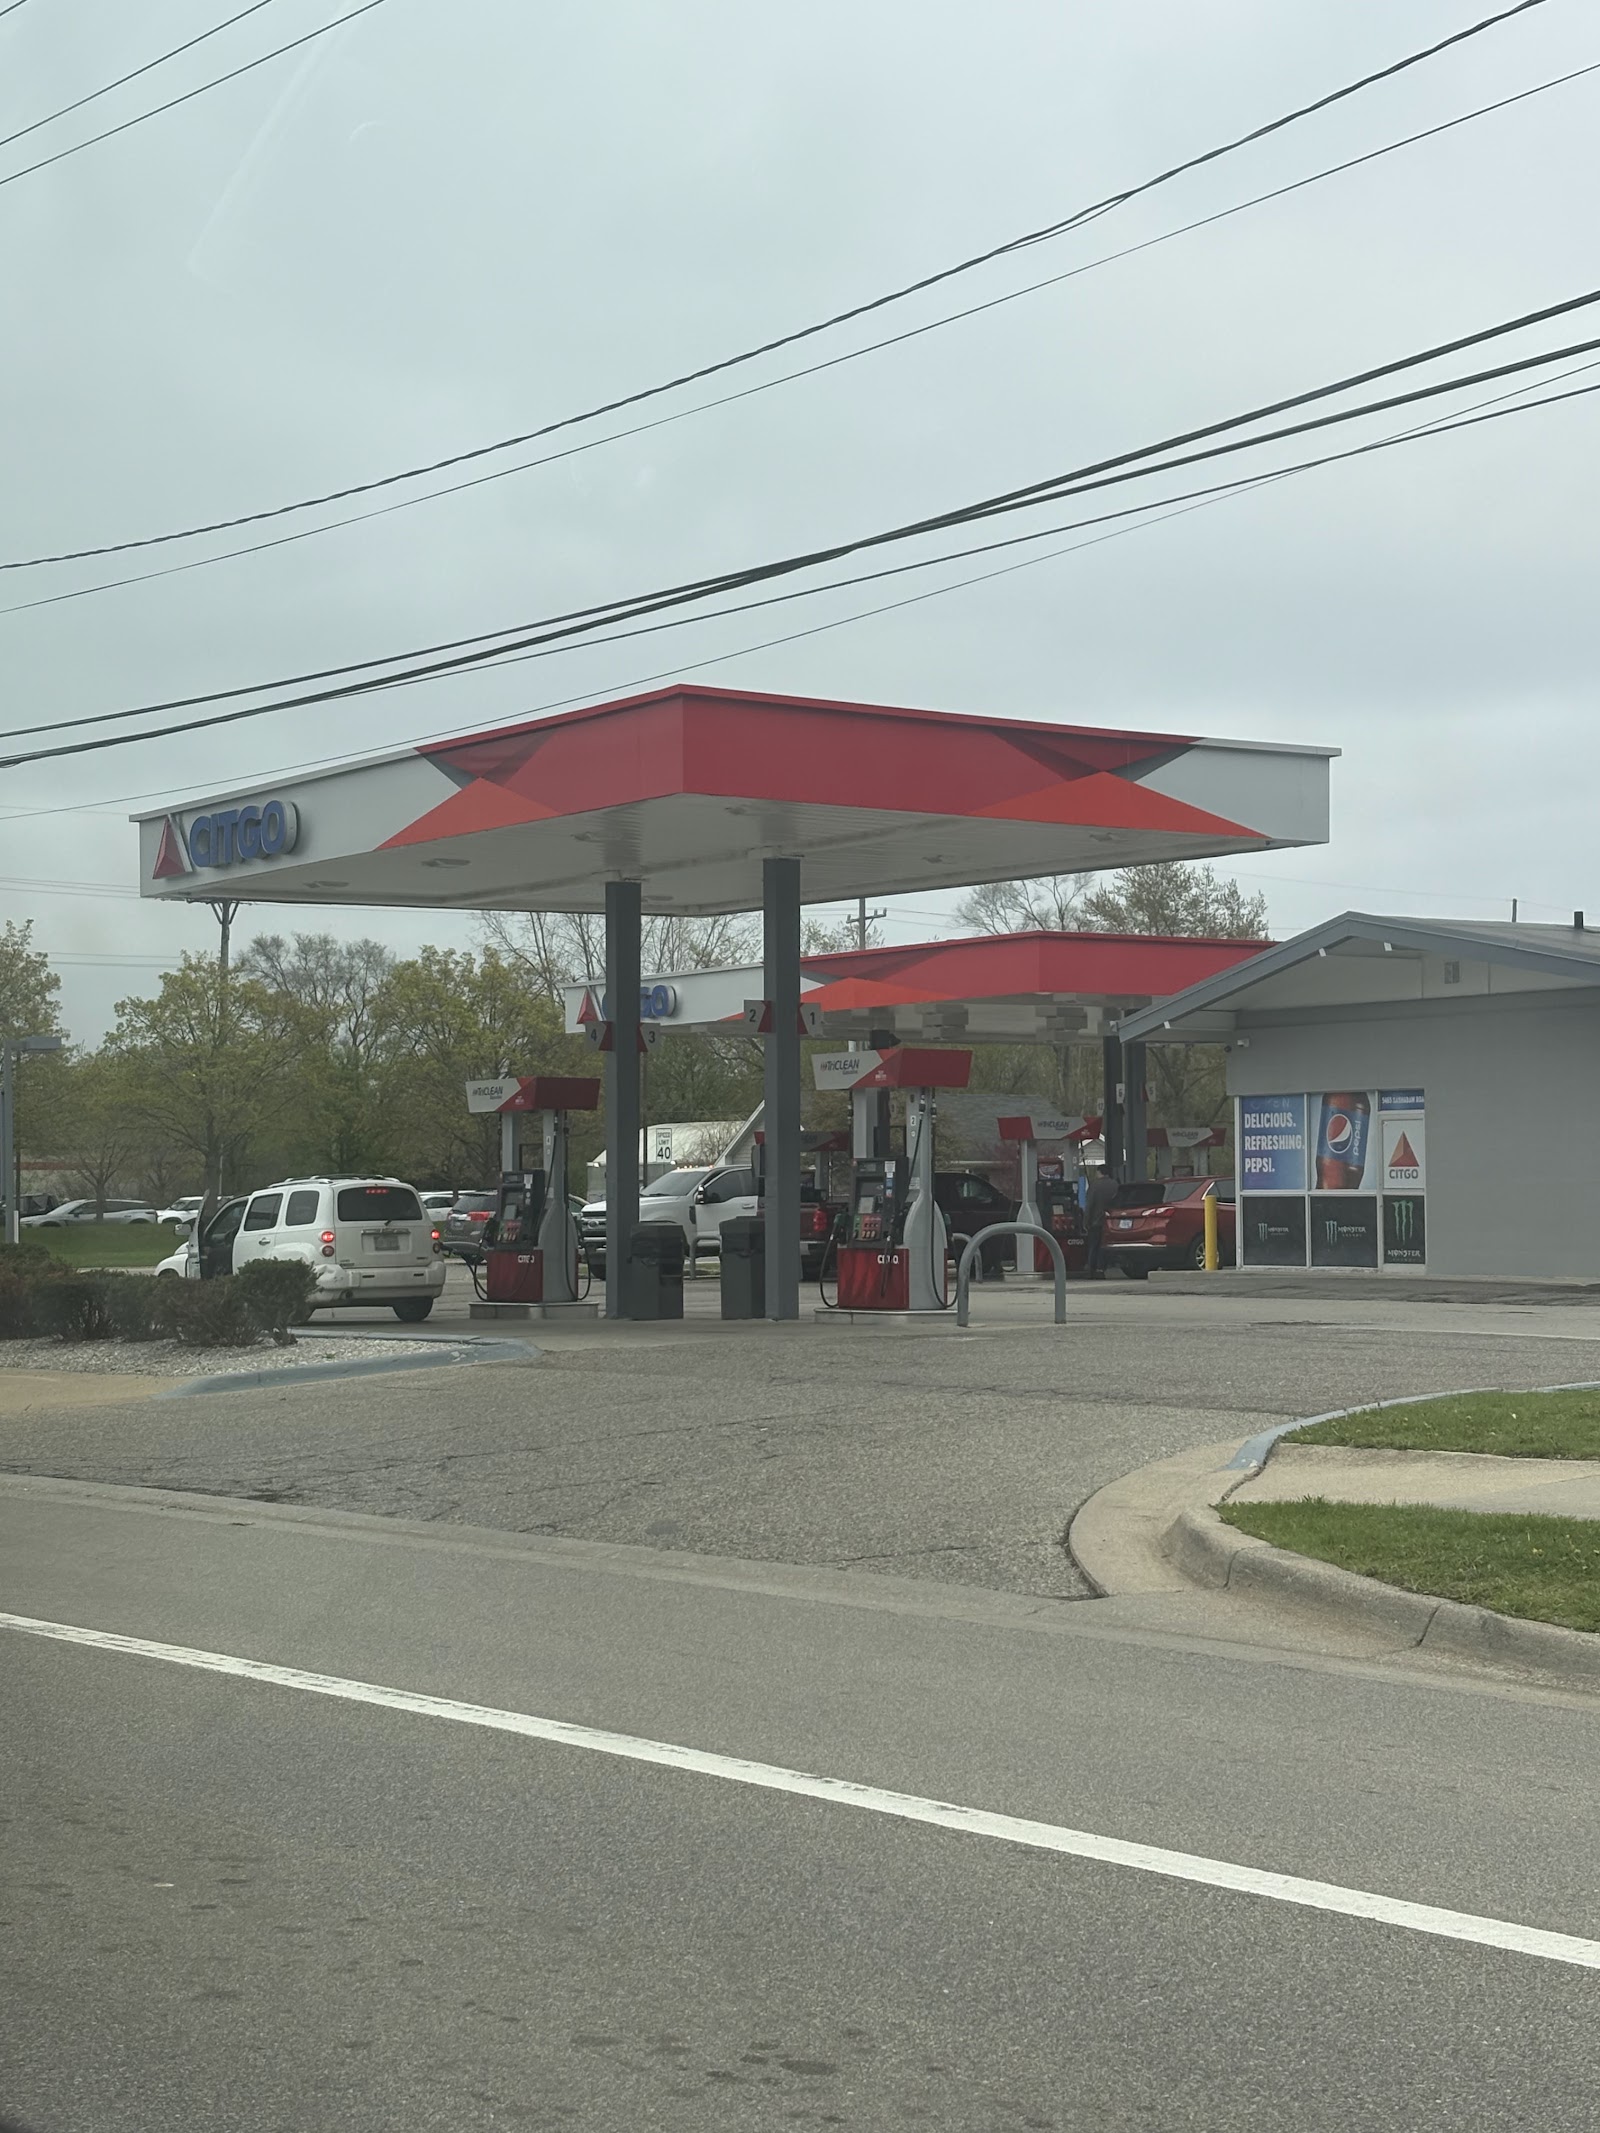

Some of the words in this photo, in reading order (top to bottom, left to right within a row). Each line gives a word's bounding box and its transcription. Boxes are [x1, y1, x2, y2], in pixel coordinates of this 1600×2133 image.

[189, 799, 294, 868] CITGO
[749, 1009, 756, 1023] 2
[809, 1012, 815, 1026] 1
[590, 1028, 597, 1042] 4
[648, 1031, 656, 1043] 3
[1244, 1111, 1297, 1128] DELICIOUS.
[1244, 1134, 1305, 1151] REFRESHING.
[1352, 1120, 1362, 1156] pepsi
[657, 1146, 671, 1160] 40
[1244, 1157, 1276, 1173] PEPSI.
[1389, 1168, 1419, 1180] CITGO
[1338, 1225, 1367, 1234] MONSTER
[1387, 1249, 1421, 1258] MONSTER
